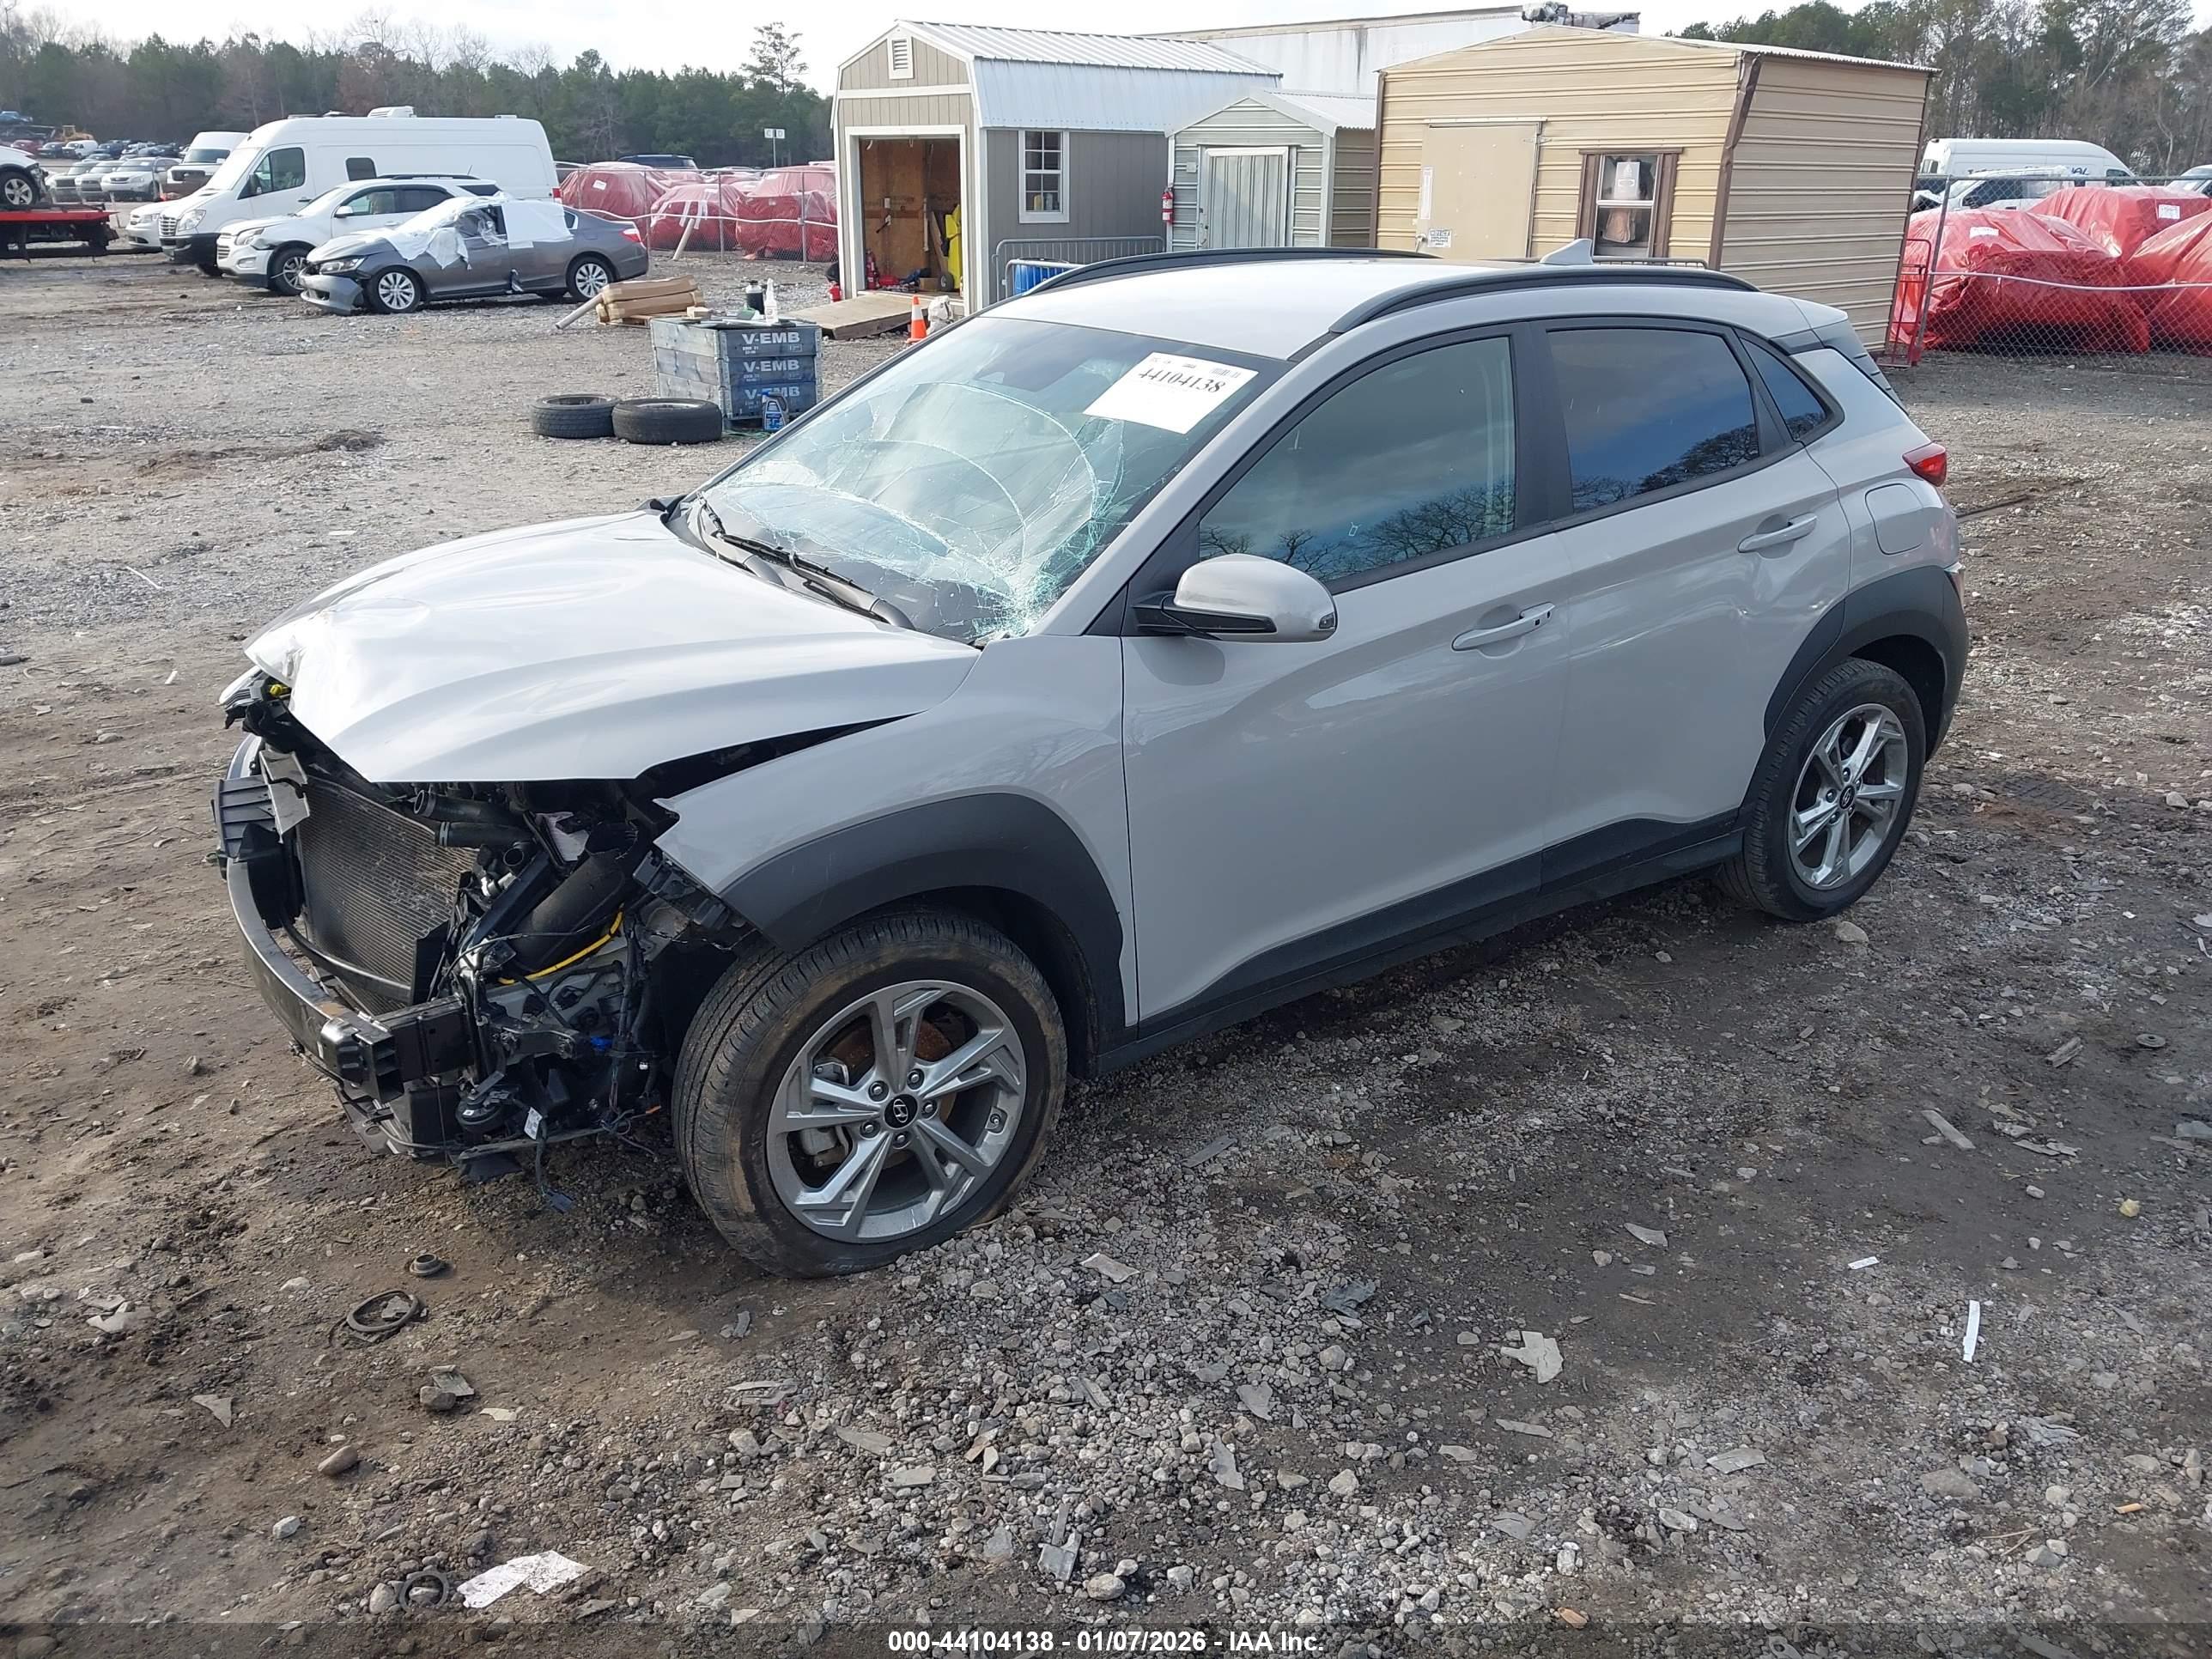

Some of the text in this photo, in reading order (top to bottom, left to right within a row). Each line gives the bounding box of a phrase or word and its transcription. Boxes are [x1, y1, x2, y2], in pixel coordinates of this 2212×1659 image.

[741, 331, 800, 344] V-EMB
[743, 359, 800, 373] V-EMB
[1138, 368, 1226, 392] 44104138
